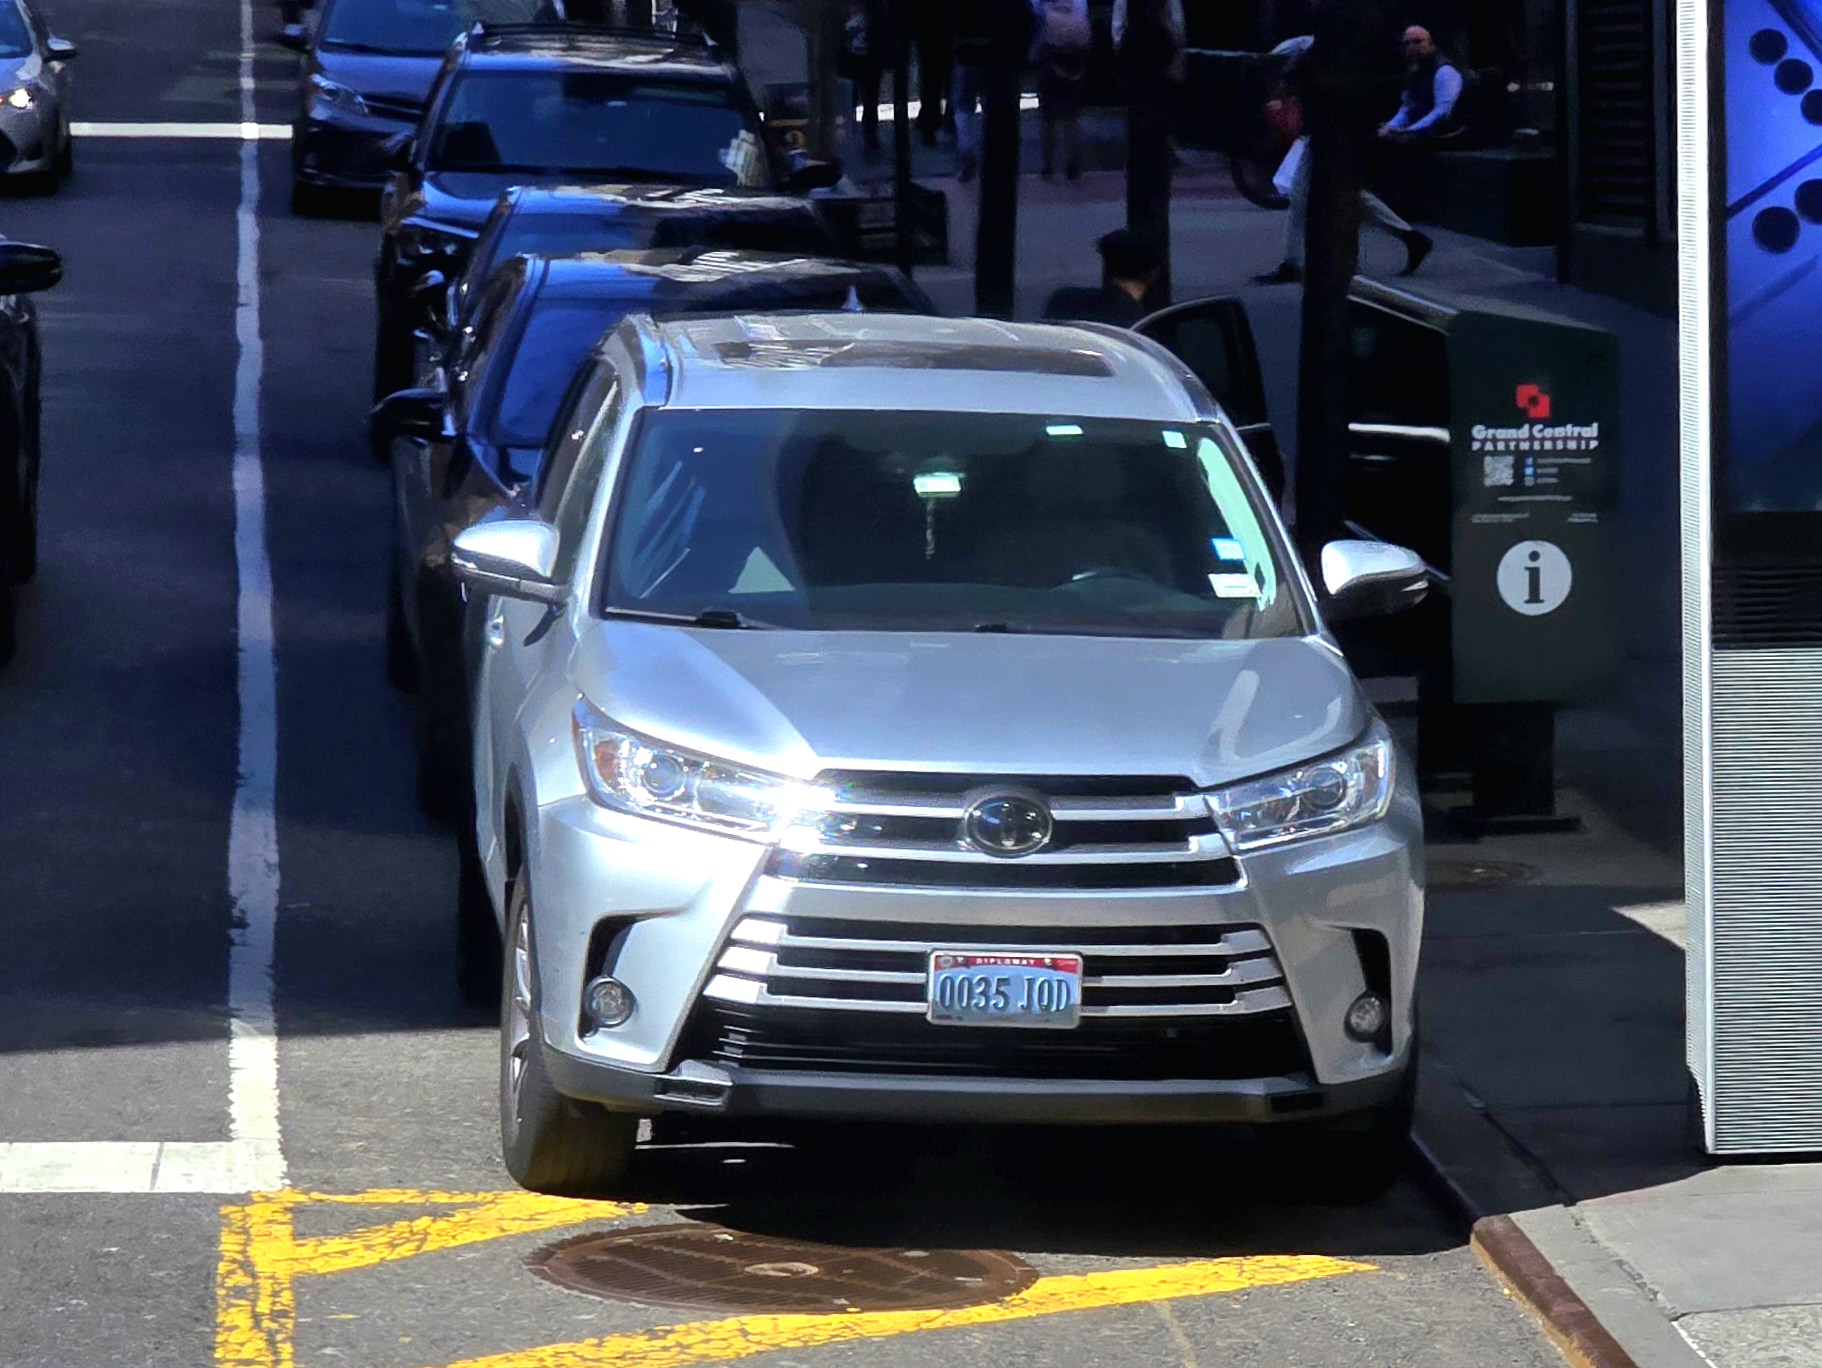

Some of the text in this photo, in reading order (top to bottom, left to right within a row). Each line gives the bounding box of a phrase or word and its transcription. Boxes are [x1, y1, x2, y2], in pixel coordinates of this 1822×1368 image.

[1472, 422, 1599, 440] Grand Central
[1472, 440, 1599, 451] PARTNERSHIP
[975, 957, 1036, 966] DIPLOMAT
[938, 974, 1012, 1012] 0035
